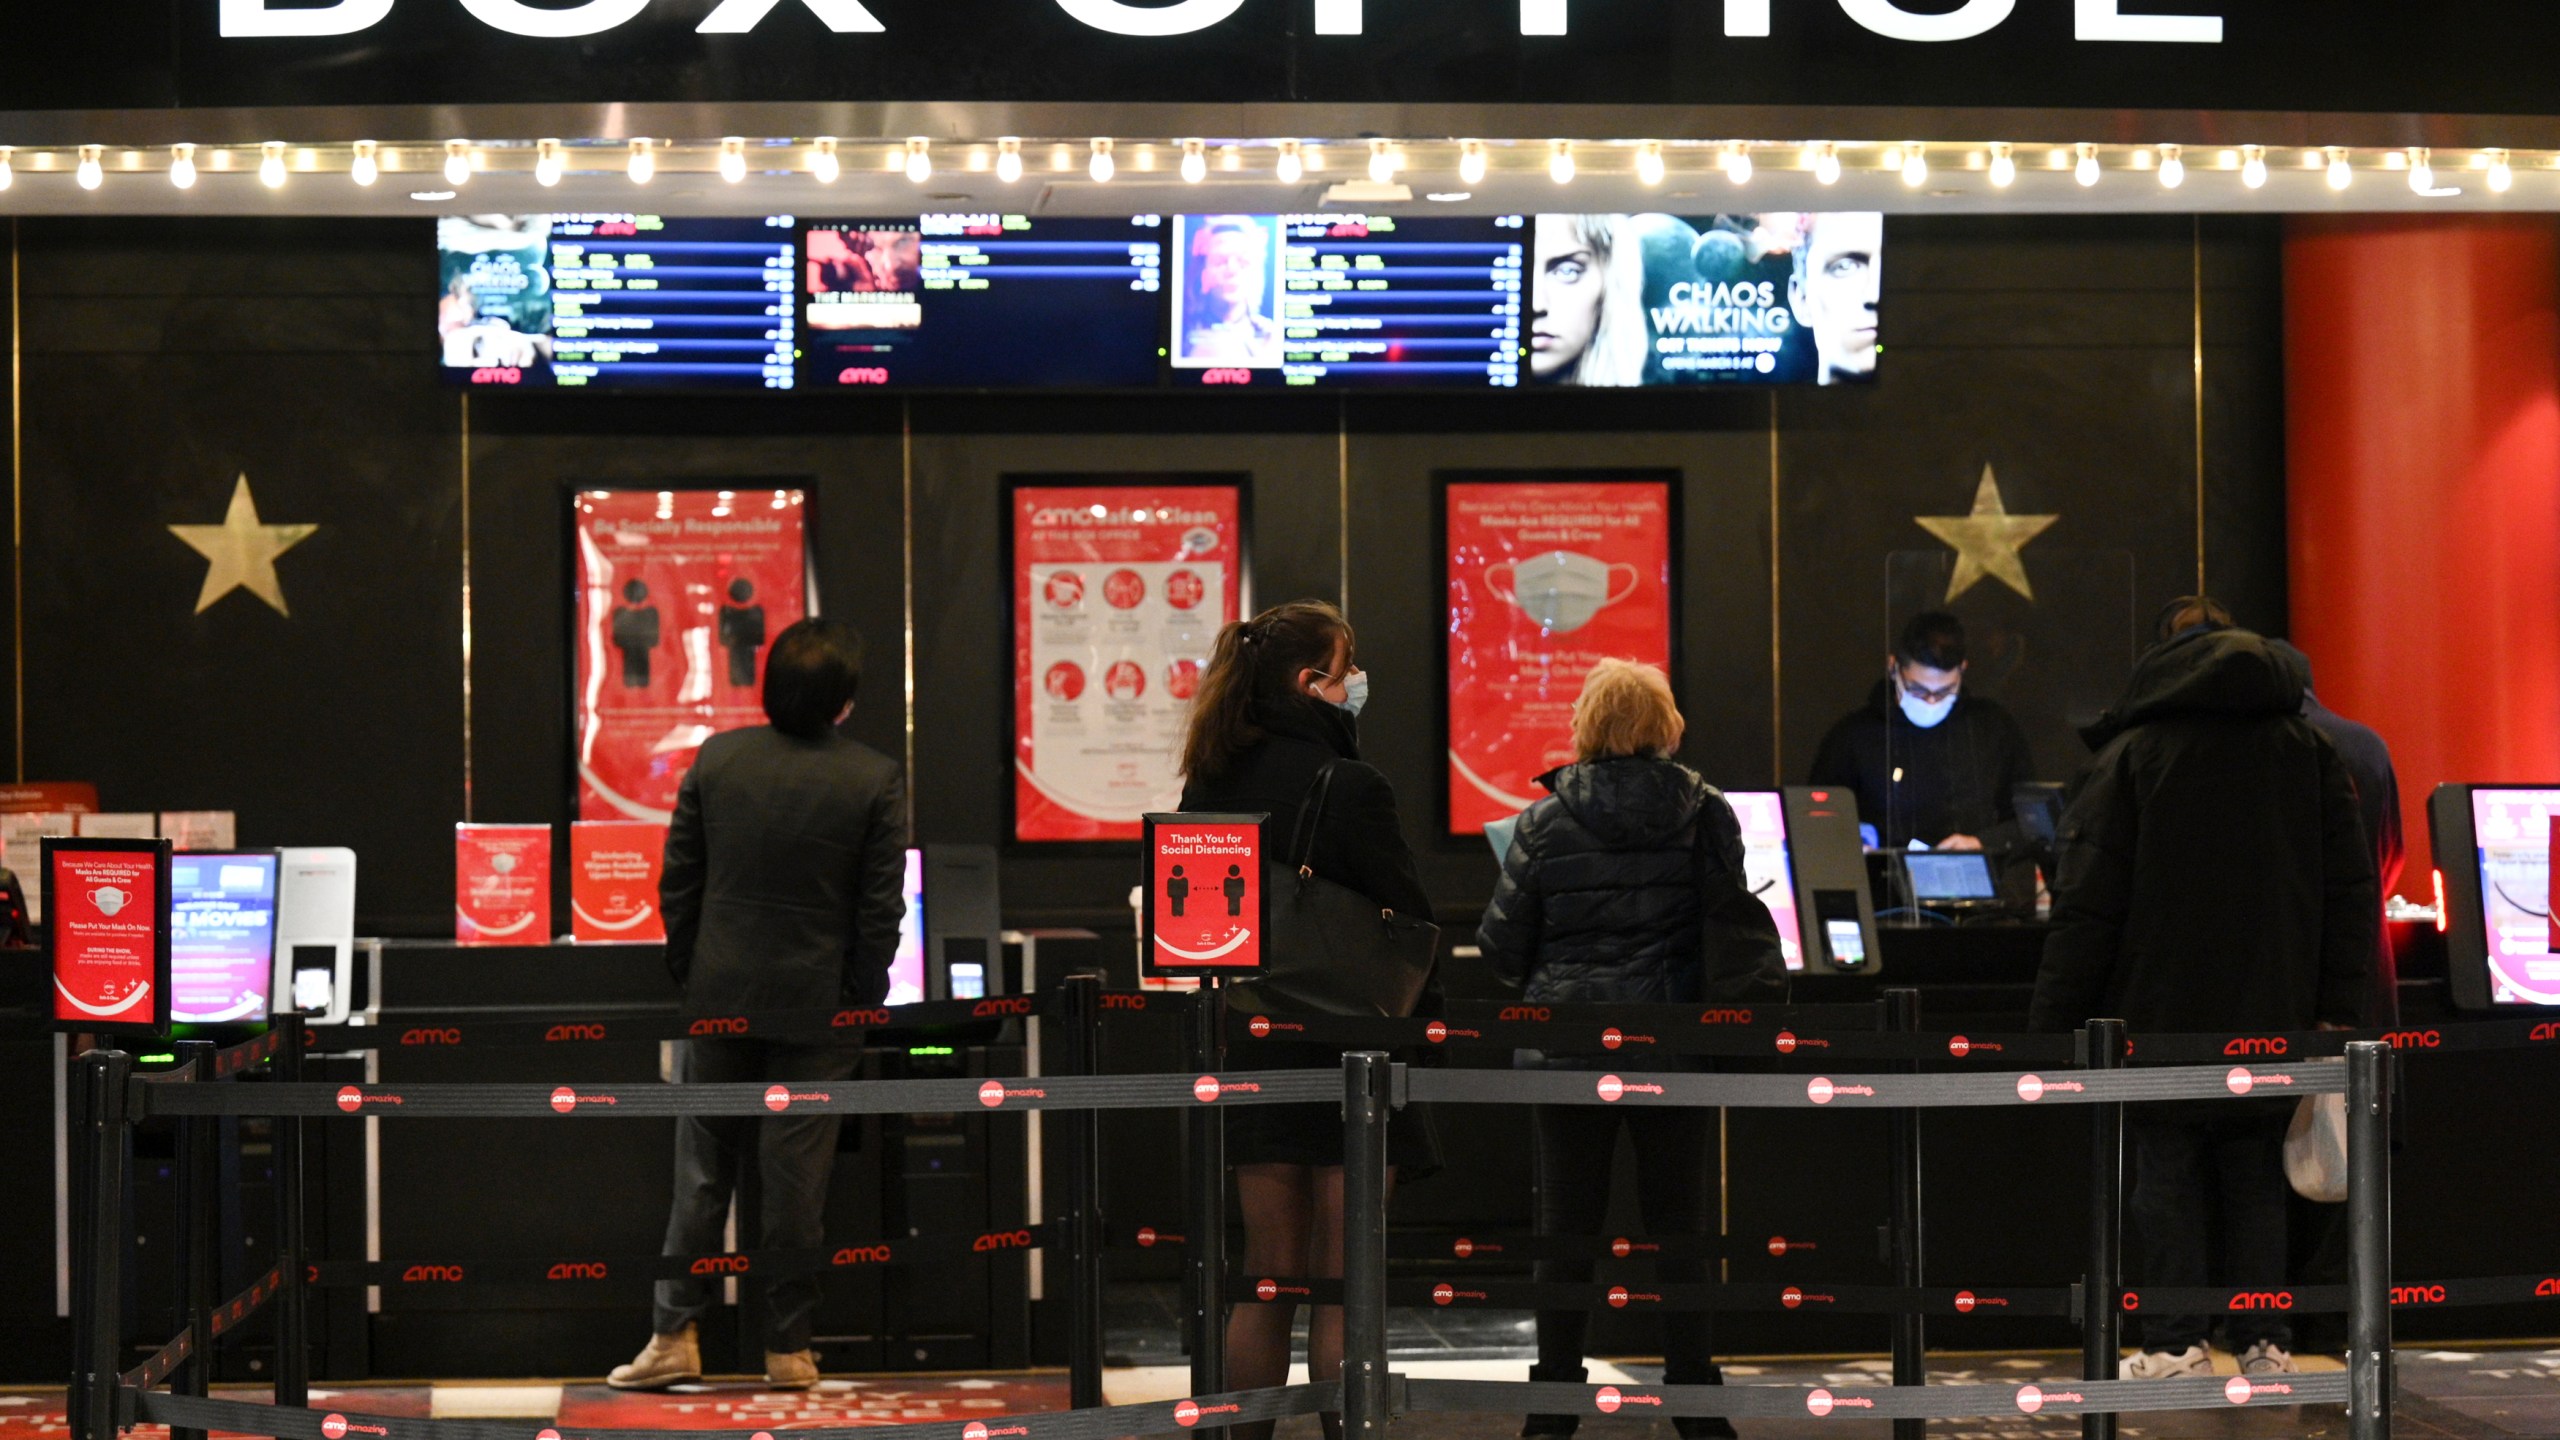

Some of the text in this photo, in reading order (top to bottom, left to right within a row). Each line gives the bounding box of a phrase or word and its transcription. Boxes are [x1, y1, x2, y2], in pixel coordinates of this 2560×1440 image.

[1669, 281, 1775, 308] CHAOS
[1650, 307, 1790, 334] WALKING
[471, 367, 521, 384] amc
[839, 367, 888, 384] amc
[1202, 368, 1251, 384] amc
[1170, 834, 1242, 844] Thank You for
[1161, 845, 1251, 856] Social Distancing
[75, 868, 92, 876] Masks
[103, 869, 131, 877] REQUIRED
[88, 922, 98, 930] Put
[99, 922, 111, 930] Your
[112, 923, 127, 931] Mask
[127, 923, 136, 931] On
[974, 997, 1029, 1017] amc
[1499, 1006, 1550, 1021] amc
[831, 1009, 890, 1027] amc
[1700, 1009, 1752, 1024] amc
[545, 1024, 606, 1041] amc
[689, 1017, 748, 1035] amc
[1250, 1022, 1270, 1030] amc
[401, 1029, 461, 1045] amc
[1603, 1034, 1622, 1042] amc
[2223, 1037, 2288, 1056] amc
[980, 1089, 1004, 1098] amc
[1195, 1084, 1219, 1093] amc
[338, 1094, 362, 1103] amc
[552, 1095, 576, 1103] amc
[765, 1093, 789, 1102] amc
[974, 1230, 1031, 1251] amc
[832, 1245, 891, 1265] amc
[403, 1265, 463, 1281] amc
[547, 1262, 606, 1279] amc
[690, 1256, 749, 1275] amc
[1782, 1293, 1802, 1301] amc
[2228, 1291, 2293, 1310] amc
[1175, 1408, 1199, 1418] amc
[323, 1421, 347, 1431] amc
[964, 1429, 988, 1439] amc
